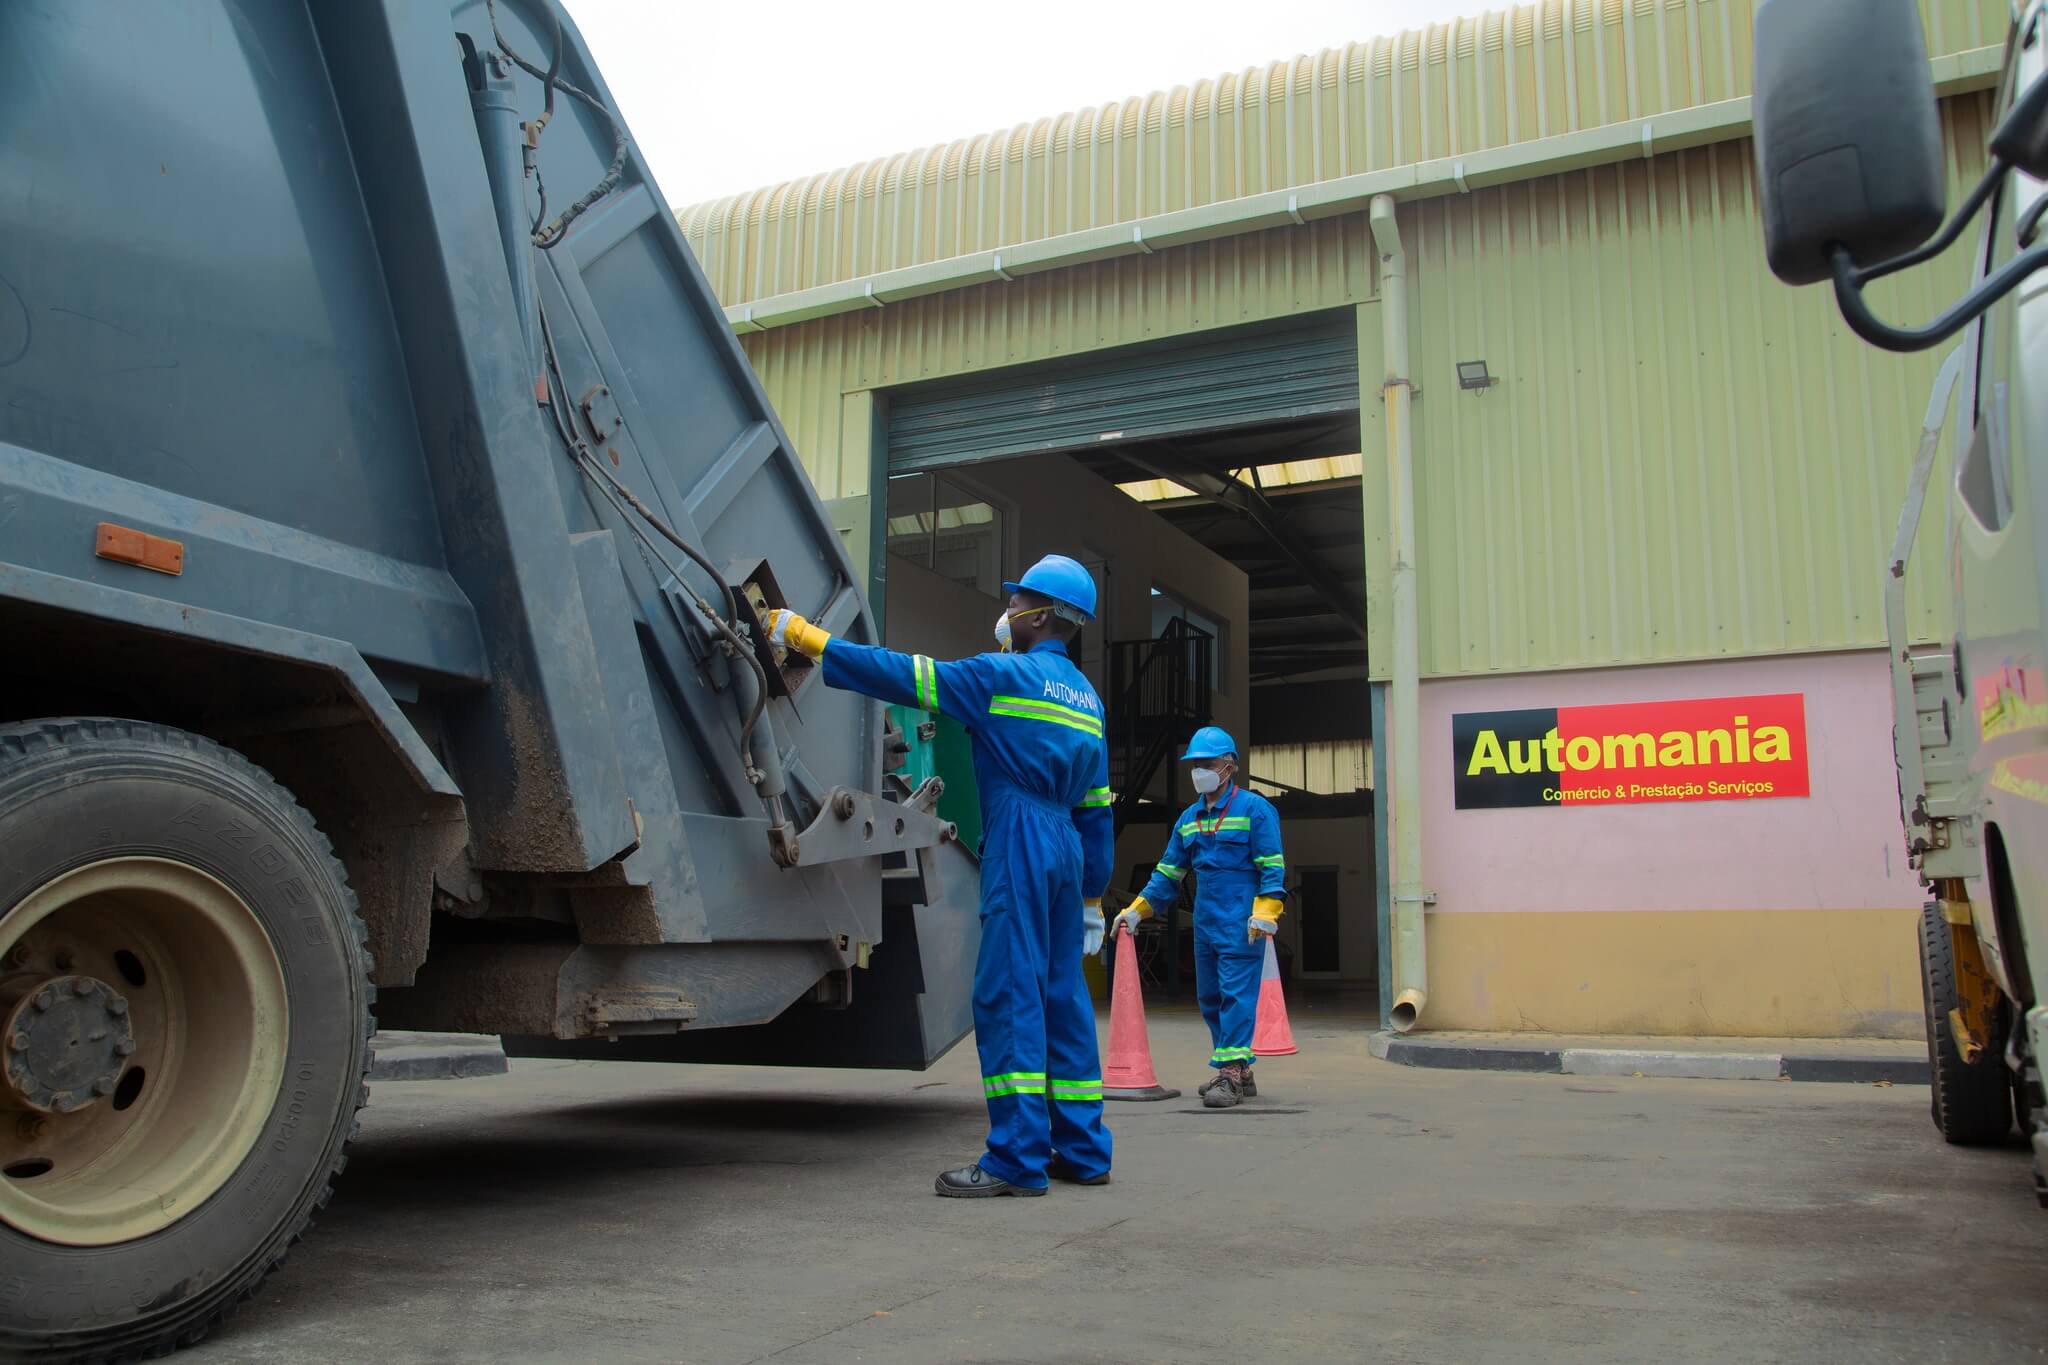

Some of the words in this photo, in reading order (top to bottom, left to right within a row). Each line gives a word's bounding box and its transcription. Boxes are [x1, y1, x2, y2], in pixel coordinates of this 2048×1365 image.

[1466, 715, 1792, 776] Automania
[1542, 784, 1612, 802] Comércio
[1615, 785, 1626, 799] &
[1630, 782, 1704, 800] Prestação
[1707, 780, 1774, 797] Serviços
